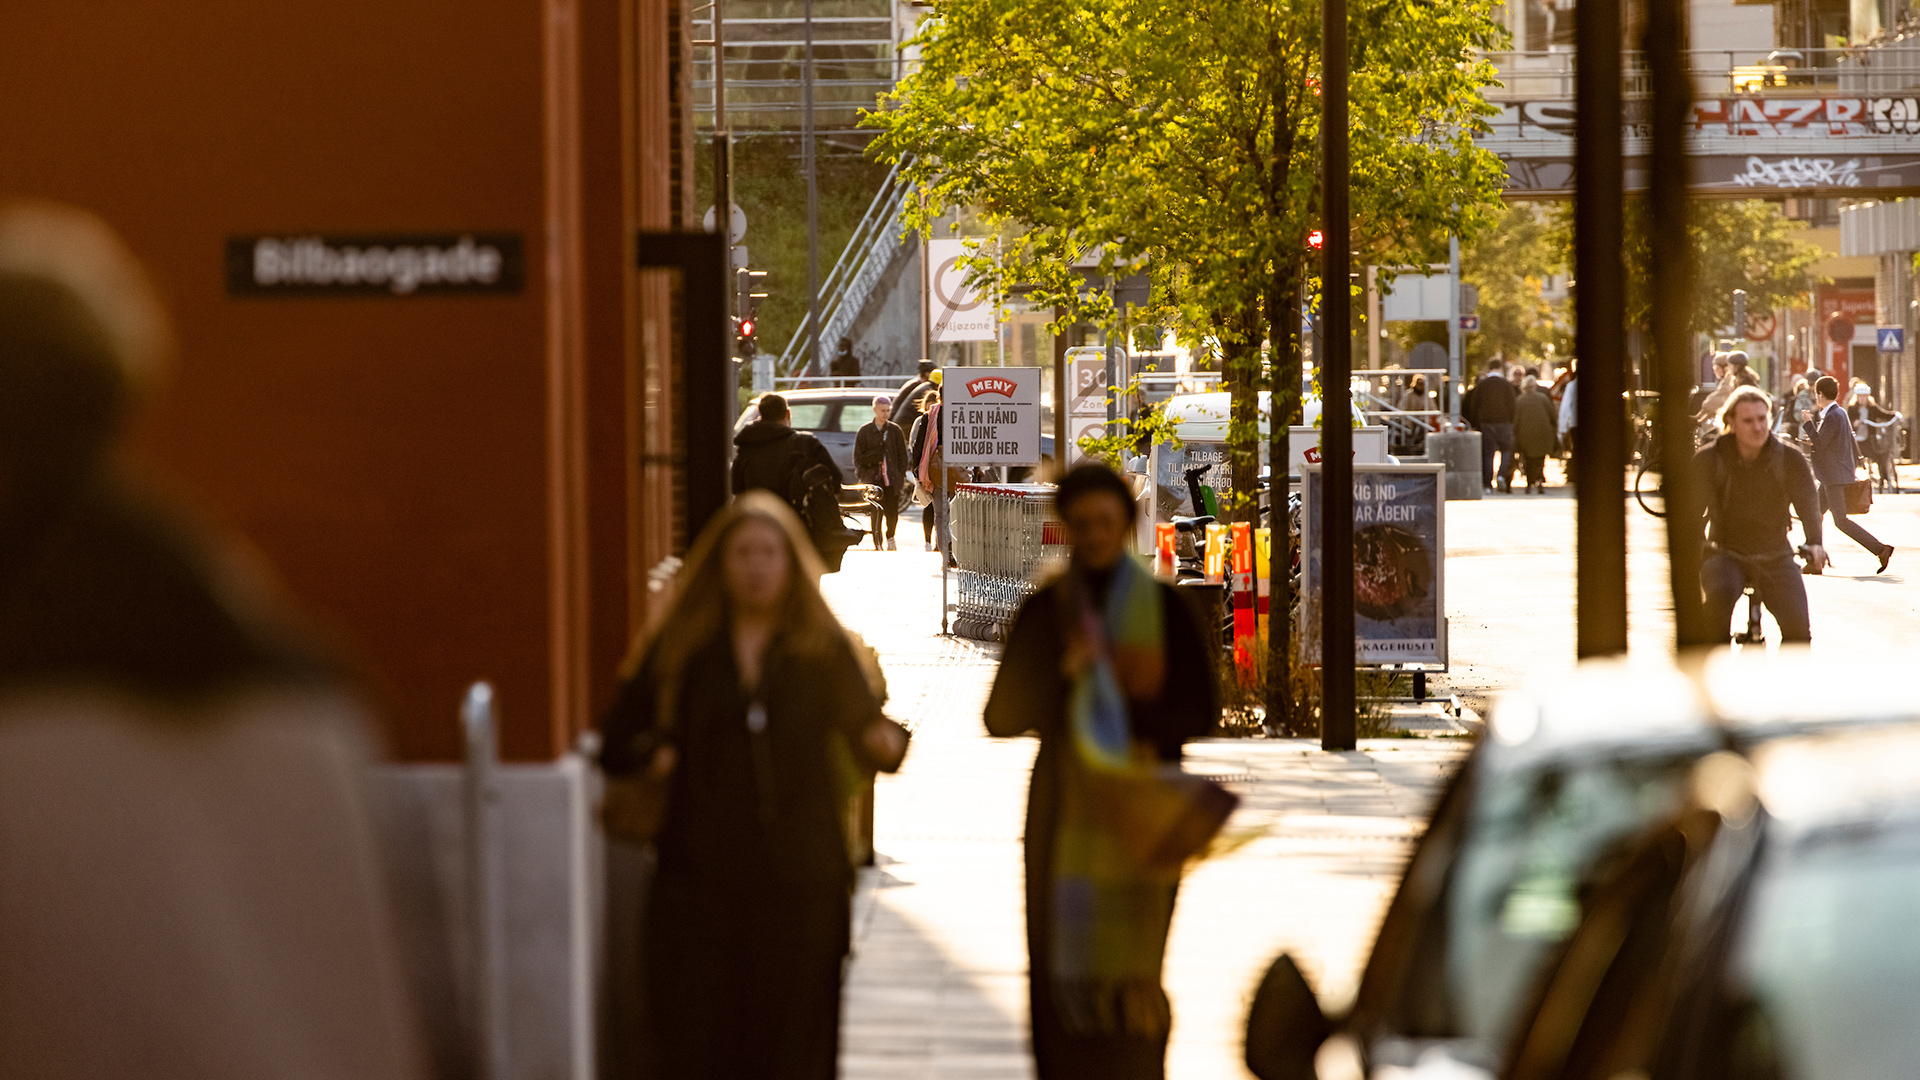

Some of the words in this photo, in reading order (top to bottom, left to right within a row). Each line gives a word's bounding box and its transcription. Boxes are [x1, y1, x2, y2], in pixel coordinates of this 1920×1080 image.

[254, 237, 502, 293] Bilbaogade
[936, 321, 990, 332] Miljøzone
[1080, 368, 1107, 388] 30
[971, 380, 1012, 393] MENY
[951, 406, 966, 424] FÅ
[968, 410, 983, 424] EN
[986, 406, 1018, 424] HÅND
[951, 426, 968, 440] TIL
[971, 426, 998, 440] DINE
[951, 440, 993, 456] INDKØB
[996, 441, 1019, 455] HER
[1190, 451, 1223, 462] TILBAGE
[1167, 462, 1179, 473] TIL
[1181, 463, 1233, 475] MADKKERI
[1375, 484, 1397, 500] IND
[1355, 506, 1373, 522] AR
[1376, 501, 1417, 522] ÅBENT
[1355, 642, 1435, 651] KAGEHUSET
